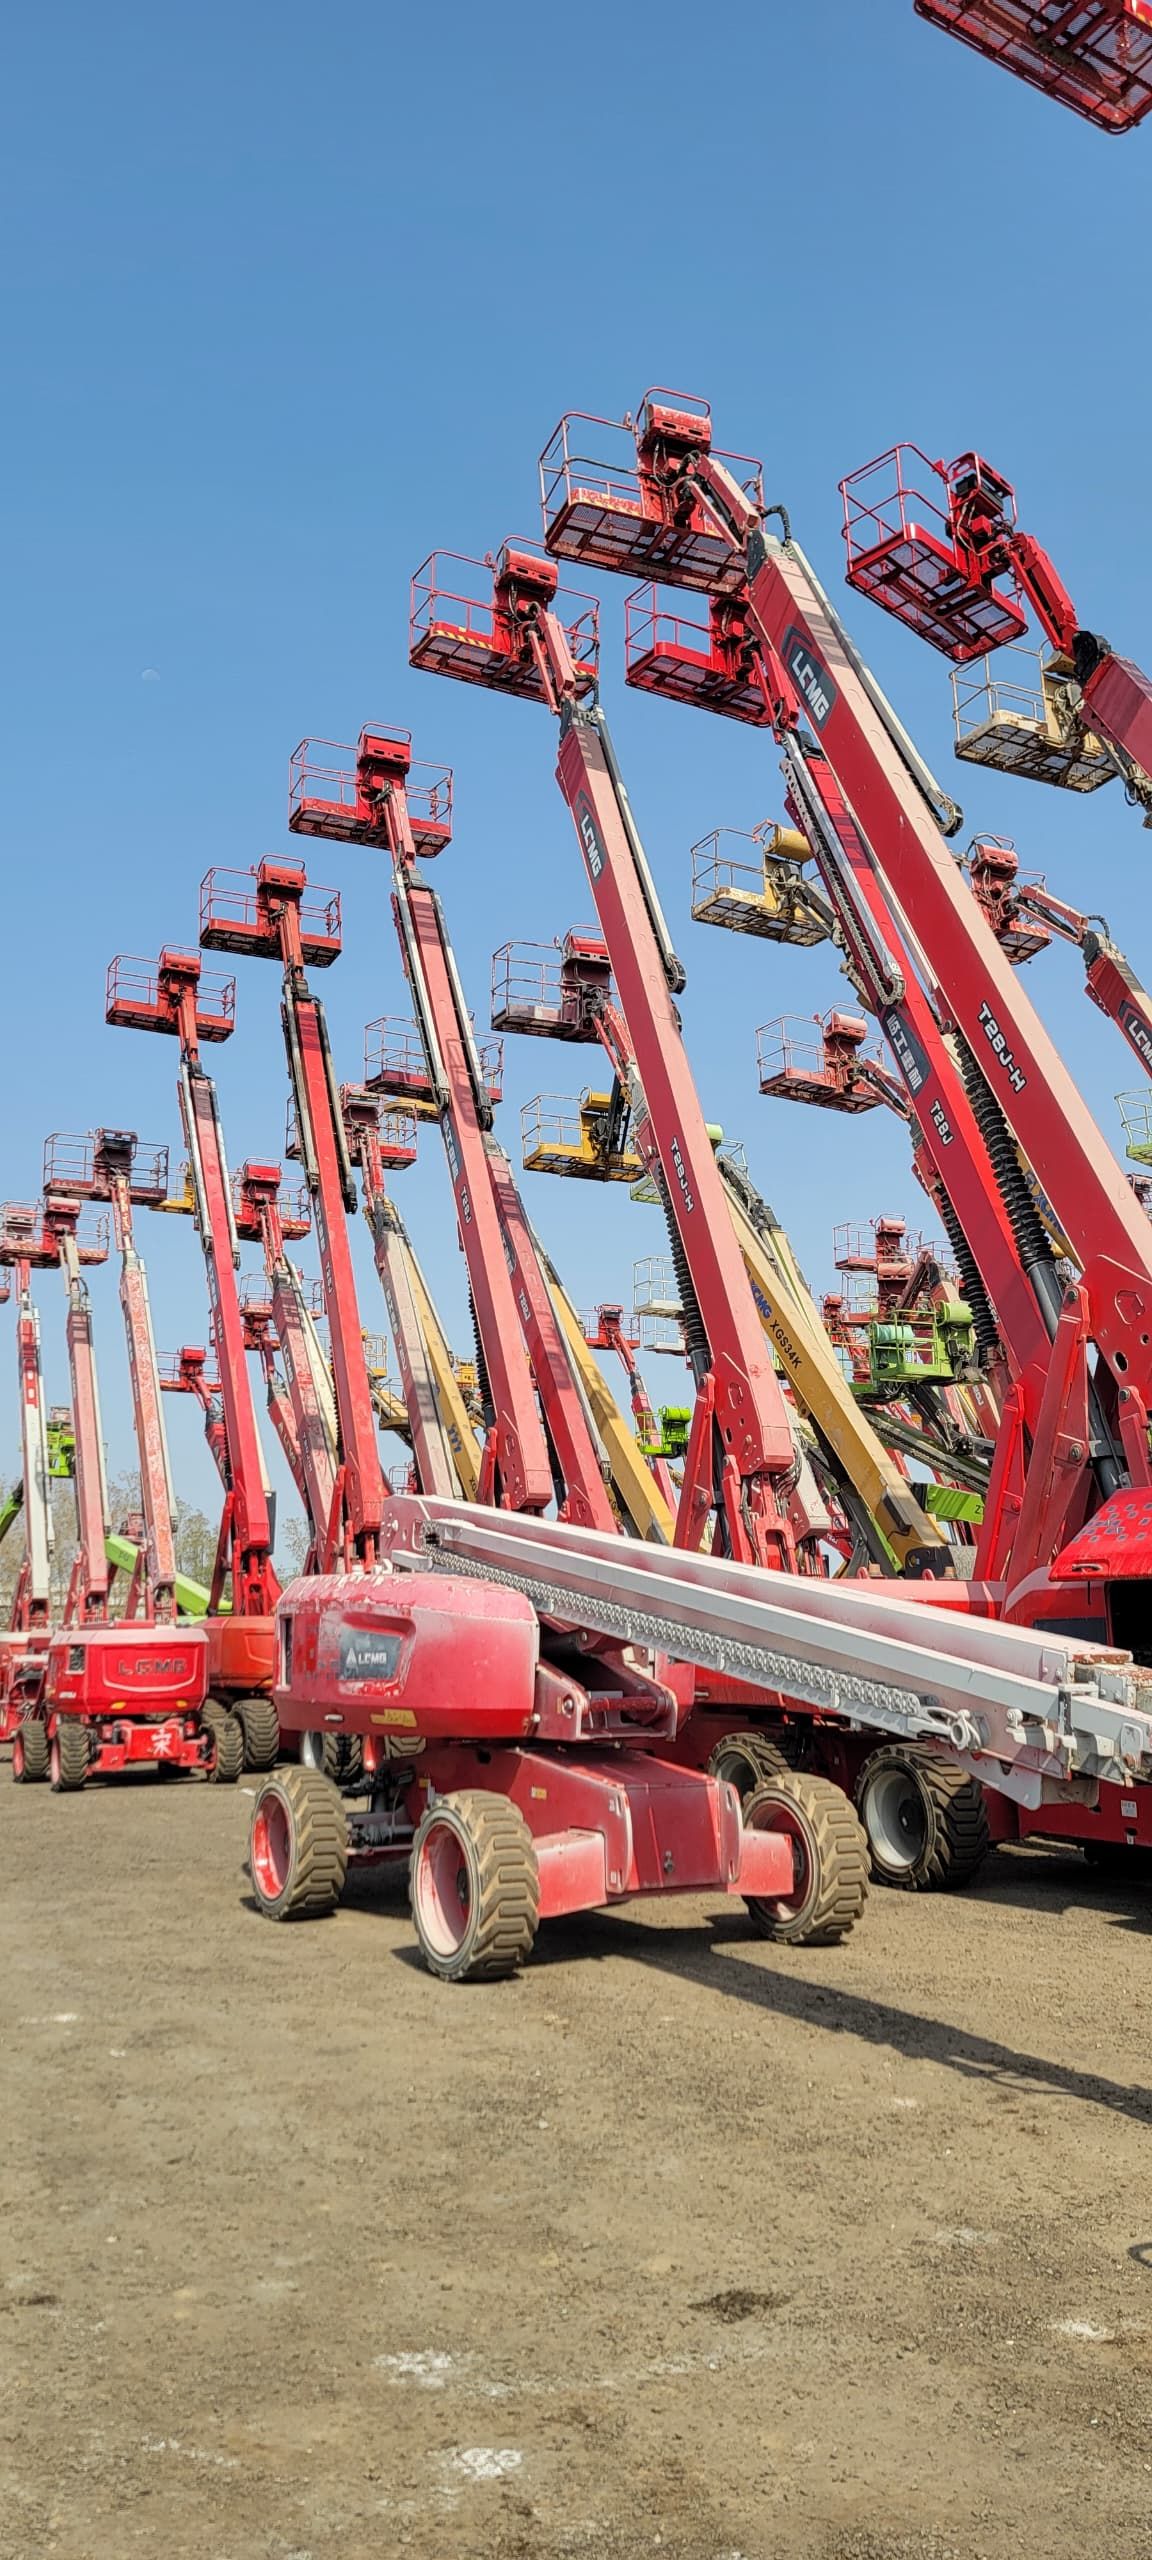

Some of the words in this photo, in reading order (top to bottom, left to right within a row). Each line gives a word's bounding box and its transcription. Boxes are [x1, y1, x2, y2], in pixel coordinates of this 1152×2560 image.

[978, 1001, 1026, 1093] T28J-H
[930, 1100, 954, 1146] T28J
[670, 1137, 694, 1212] T28J-H
[769, 1319, 802, 1370] XGS34K
